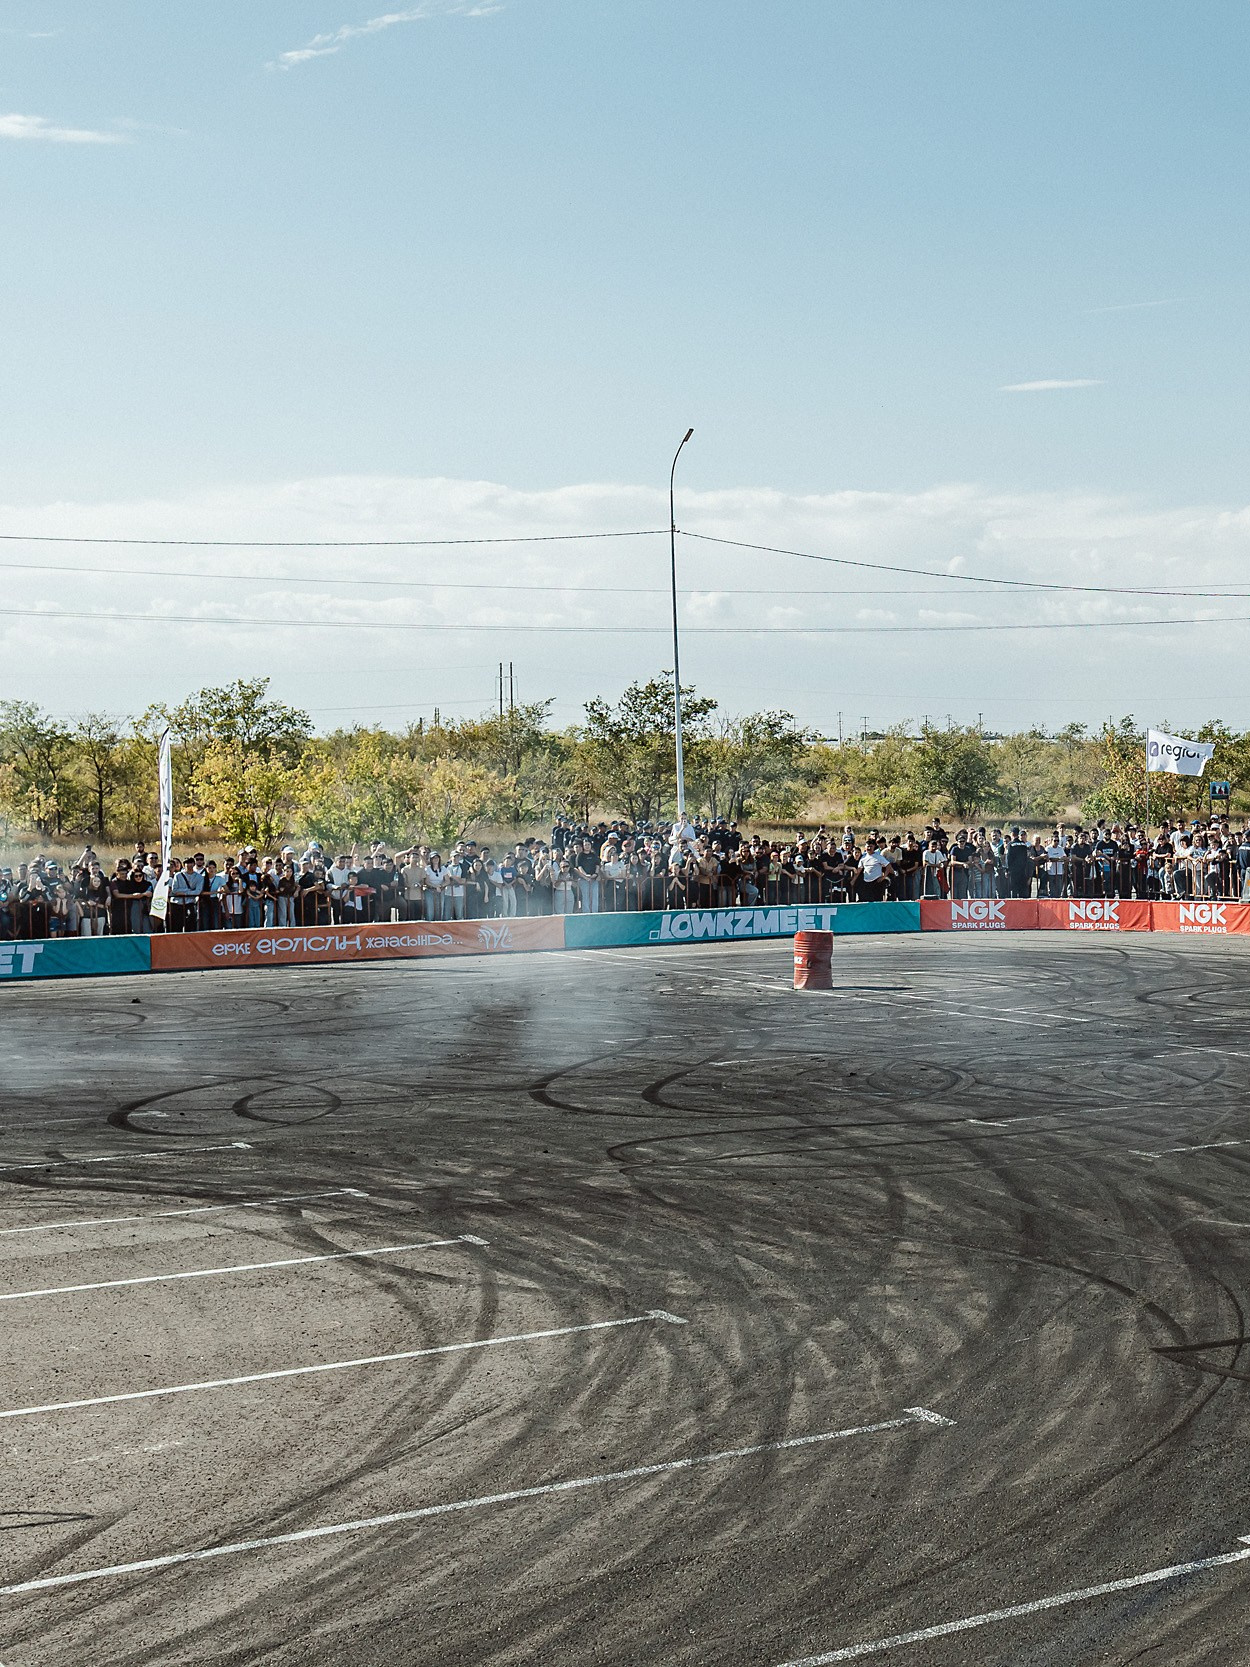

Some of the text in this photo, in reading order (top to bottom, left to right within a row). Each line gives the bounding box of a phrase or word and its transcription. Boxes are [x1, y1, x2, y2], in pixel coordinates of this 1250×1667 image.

[951, 900, 1006, 920] NGK
[1069, 901, 1120, 922] NGK
[1179, 903, 1227, 923] NGK
[980, 921, 1006, 929] PLUGS
[1095, 922, 1120, 930] PLUGS
